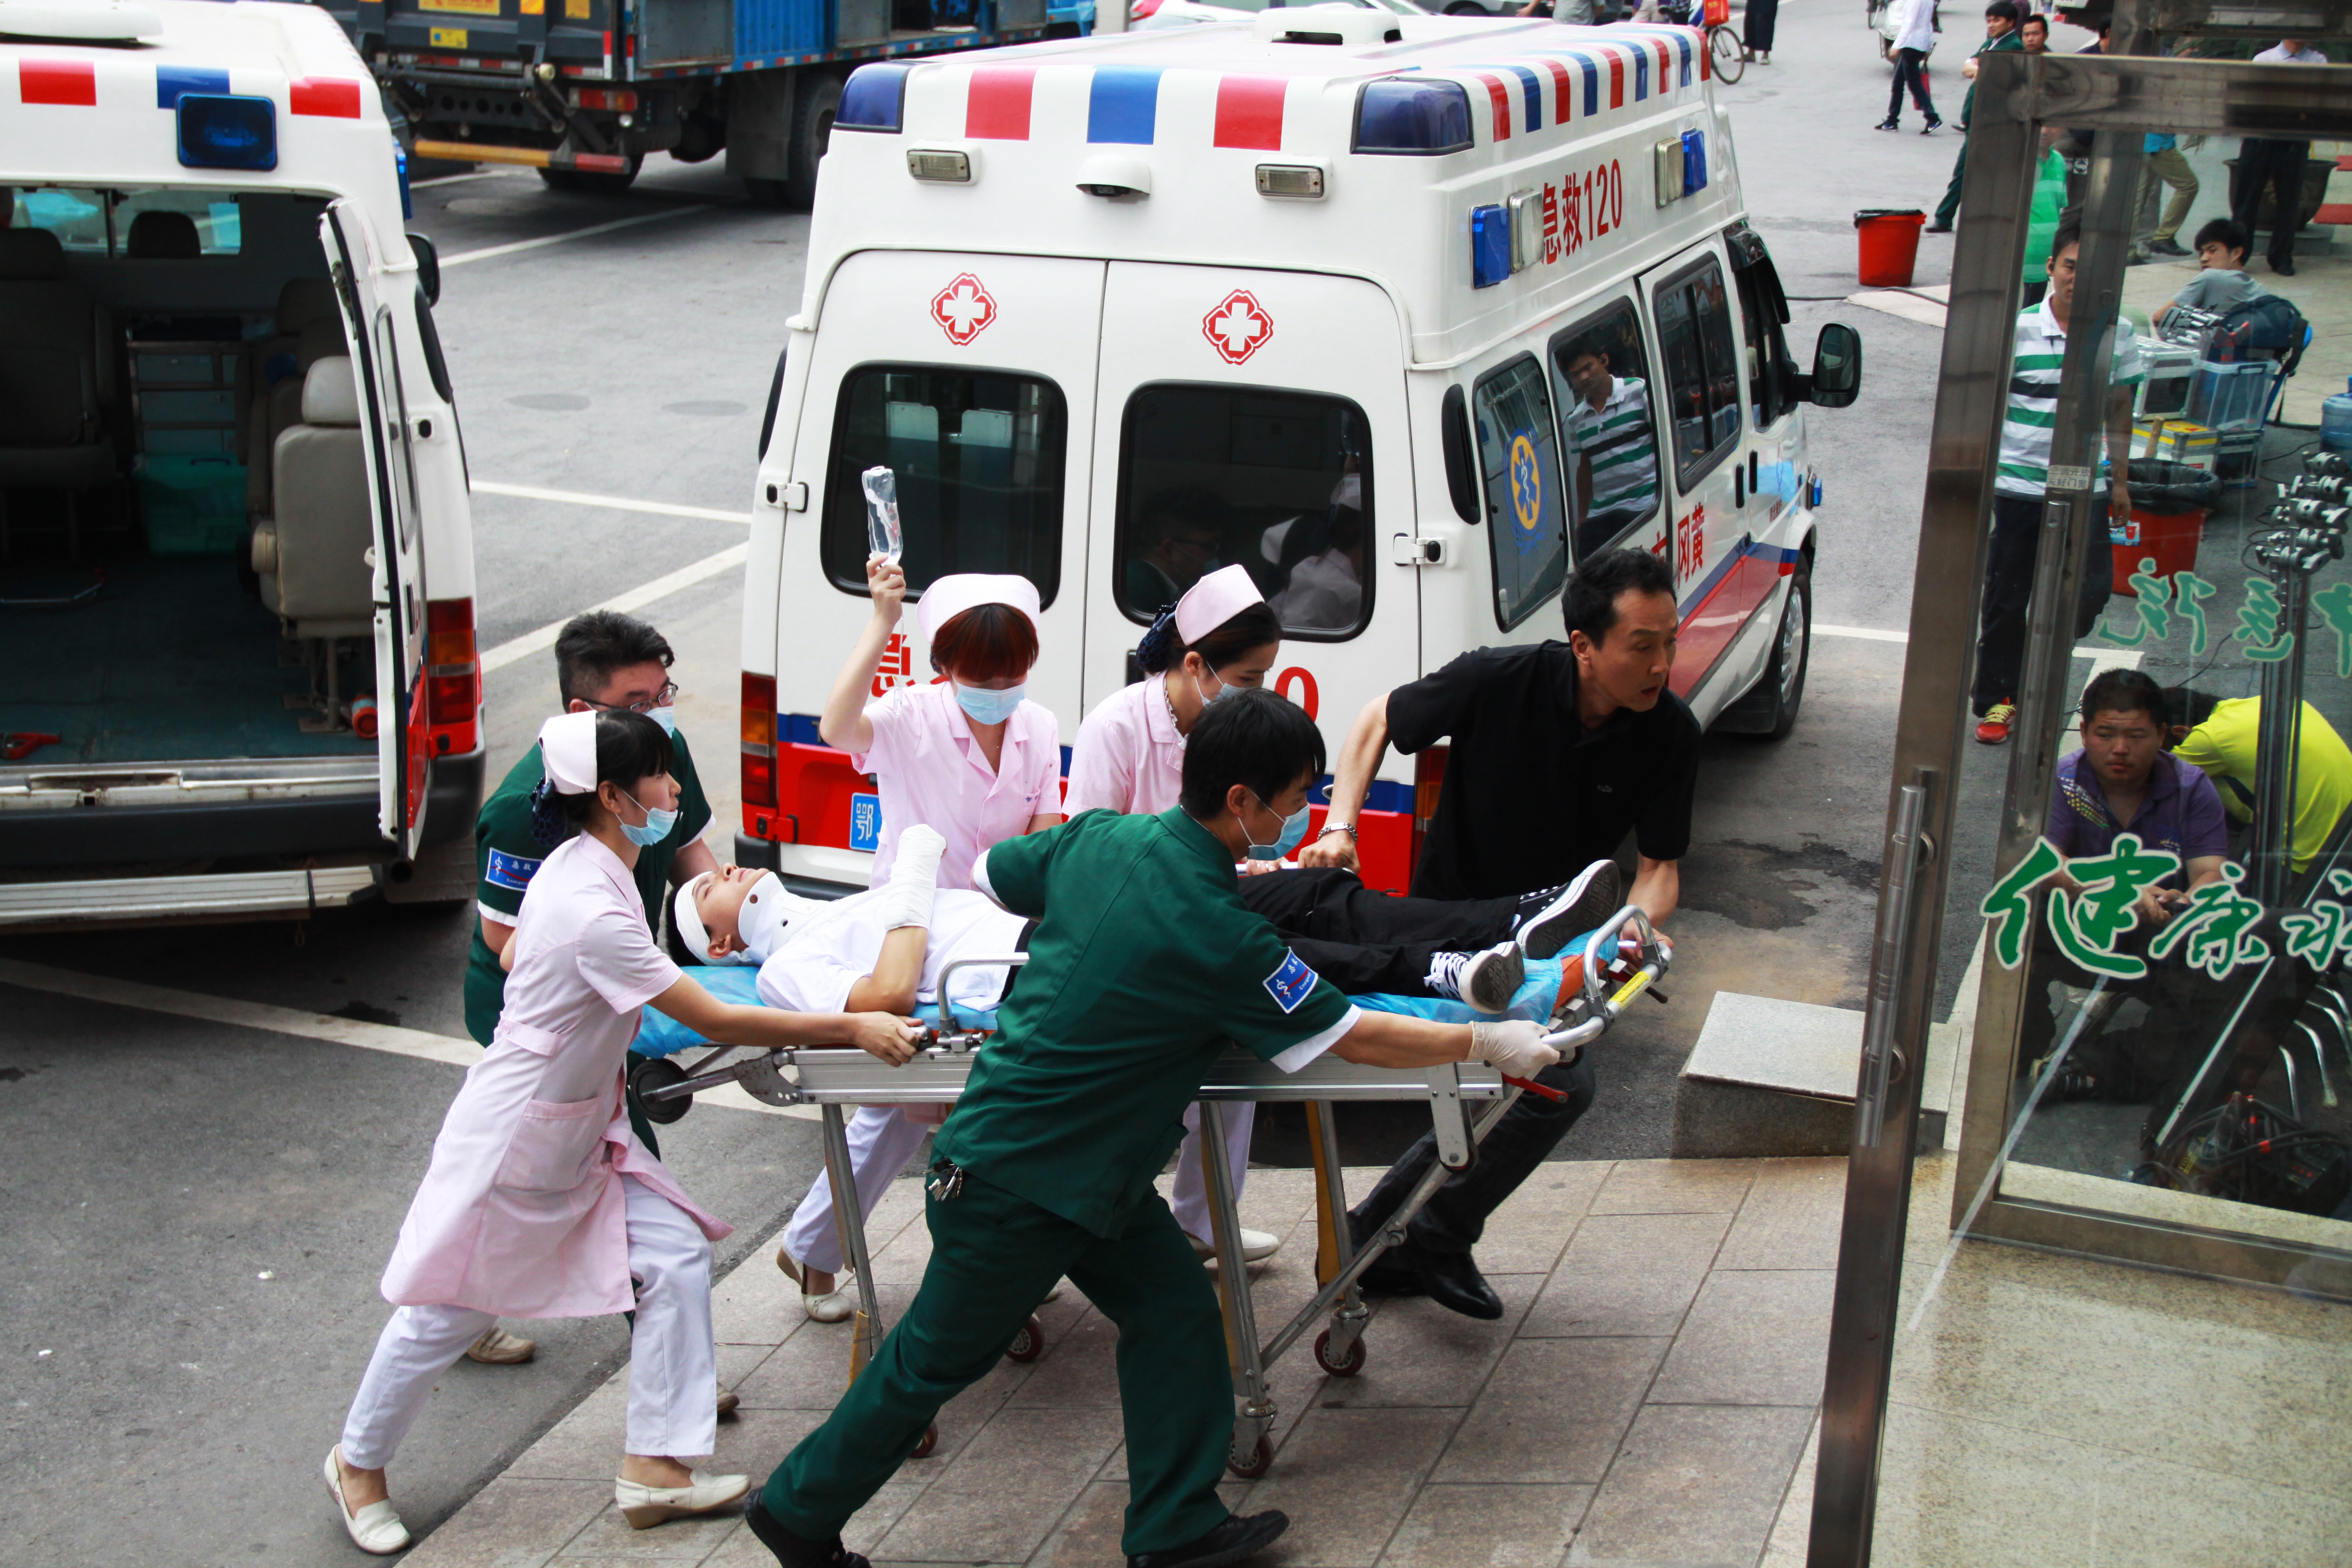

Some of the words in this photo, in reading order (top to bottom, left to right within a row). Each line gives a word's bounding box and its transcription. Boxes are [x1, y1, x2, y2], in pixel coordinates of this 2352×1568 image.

[1540, 158, 1623, 266] 急救120
[855, 802, 880, 841] 鄂
[512, 860, 531, 871] 急救
